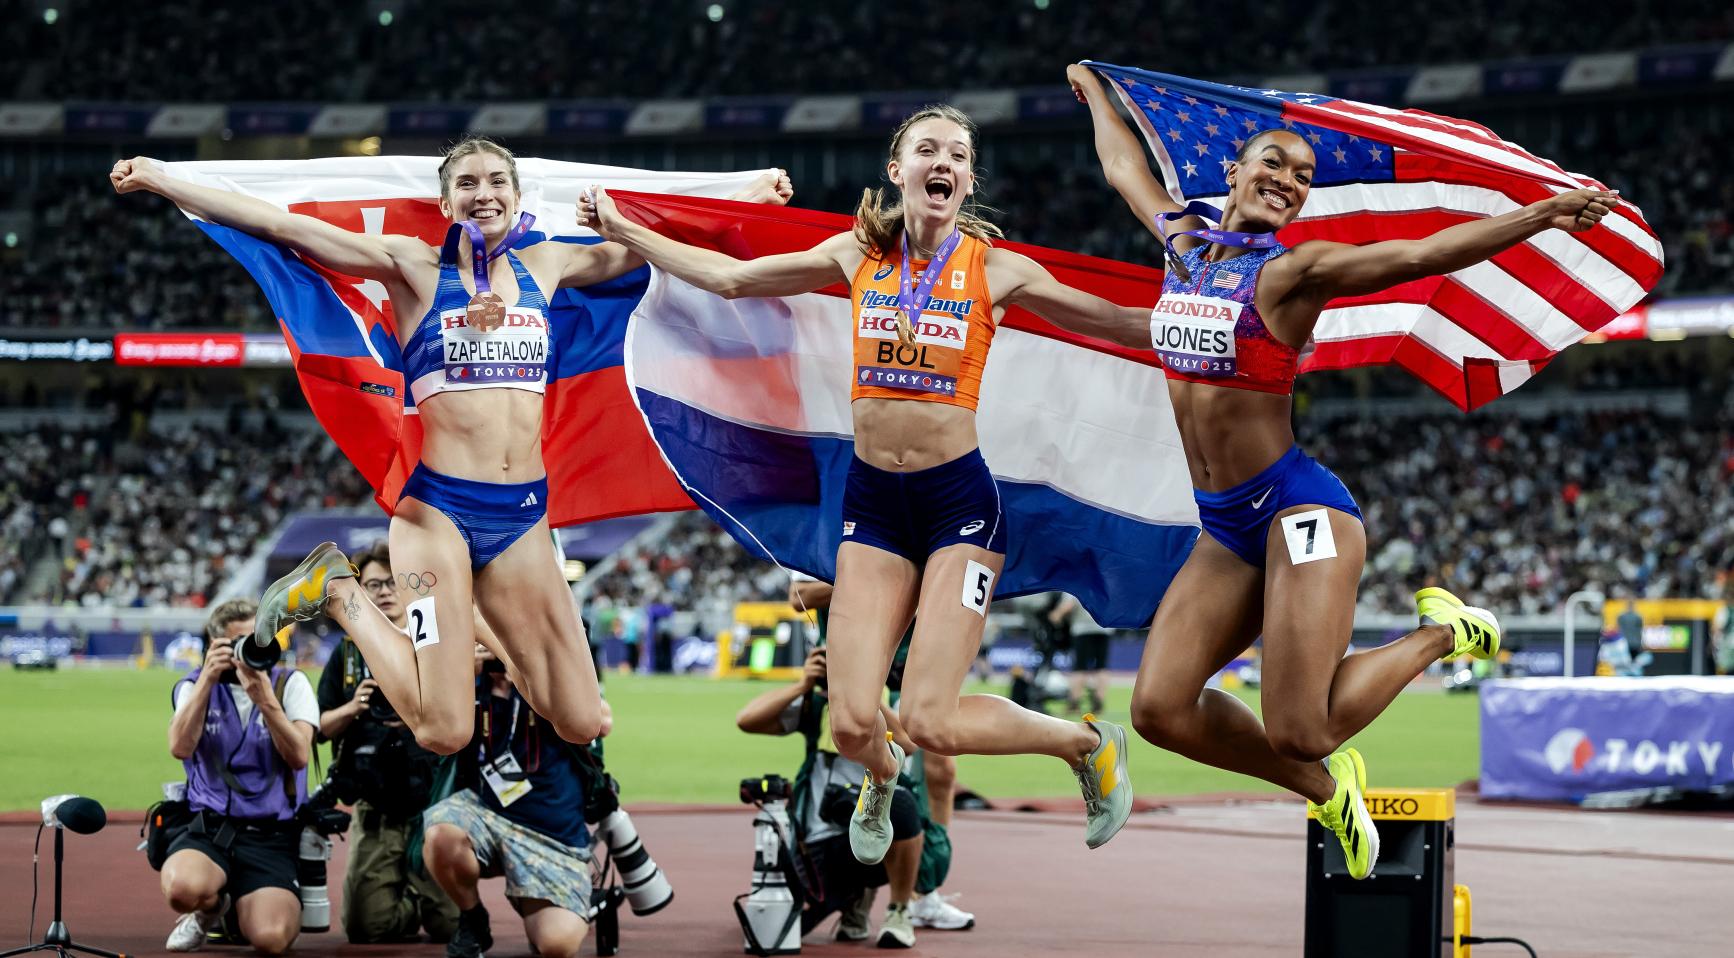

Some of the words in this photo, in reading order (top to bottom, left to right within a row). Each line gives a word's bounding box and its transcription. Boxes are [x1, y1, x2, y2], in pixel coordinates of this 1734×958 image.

[443, 313, 543, 330] HDA
[1155, 301, 1234, 321] HONDA
[861, 316, 963, 341] HODA
[1155, 324, 1228, 354] JONES
[448, 335, 544, 362] ZAPLETALOVÁ
[877, 341, 935, 369] BOL
[1295, 518, 1318, 555] 7
[974, 571, 989, 607] 5
[411, 608, 427, 643] 2
[1604, 737, 1734, 776] TOKY
[1365, 797, 1419, 816] IKO
